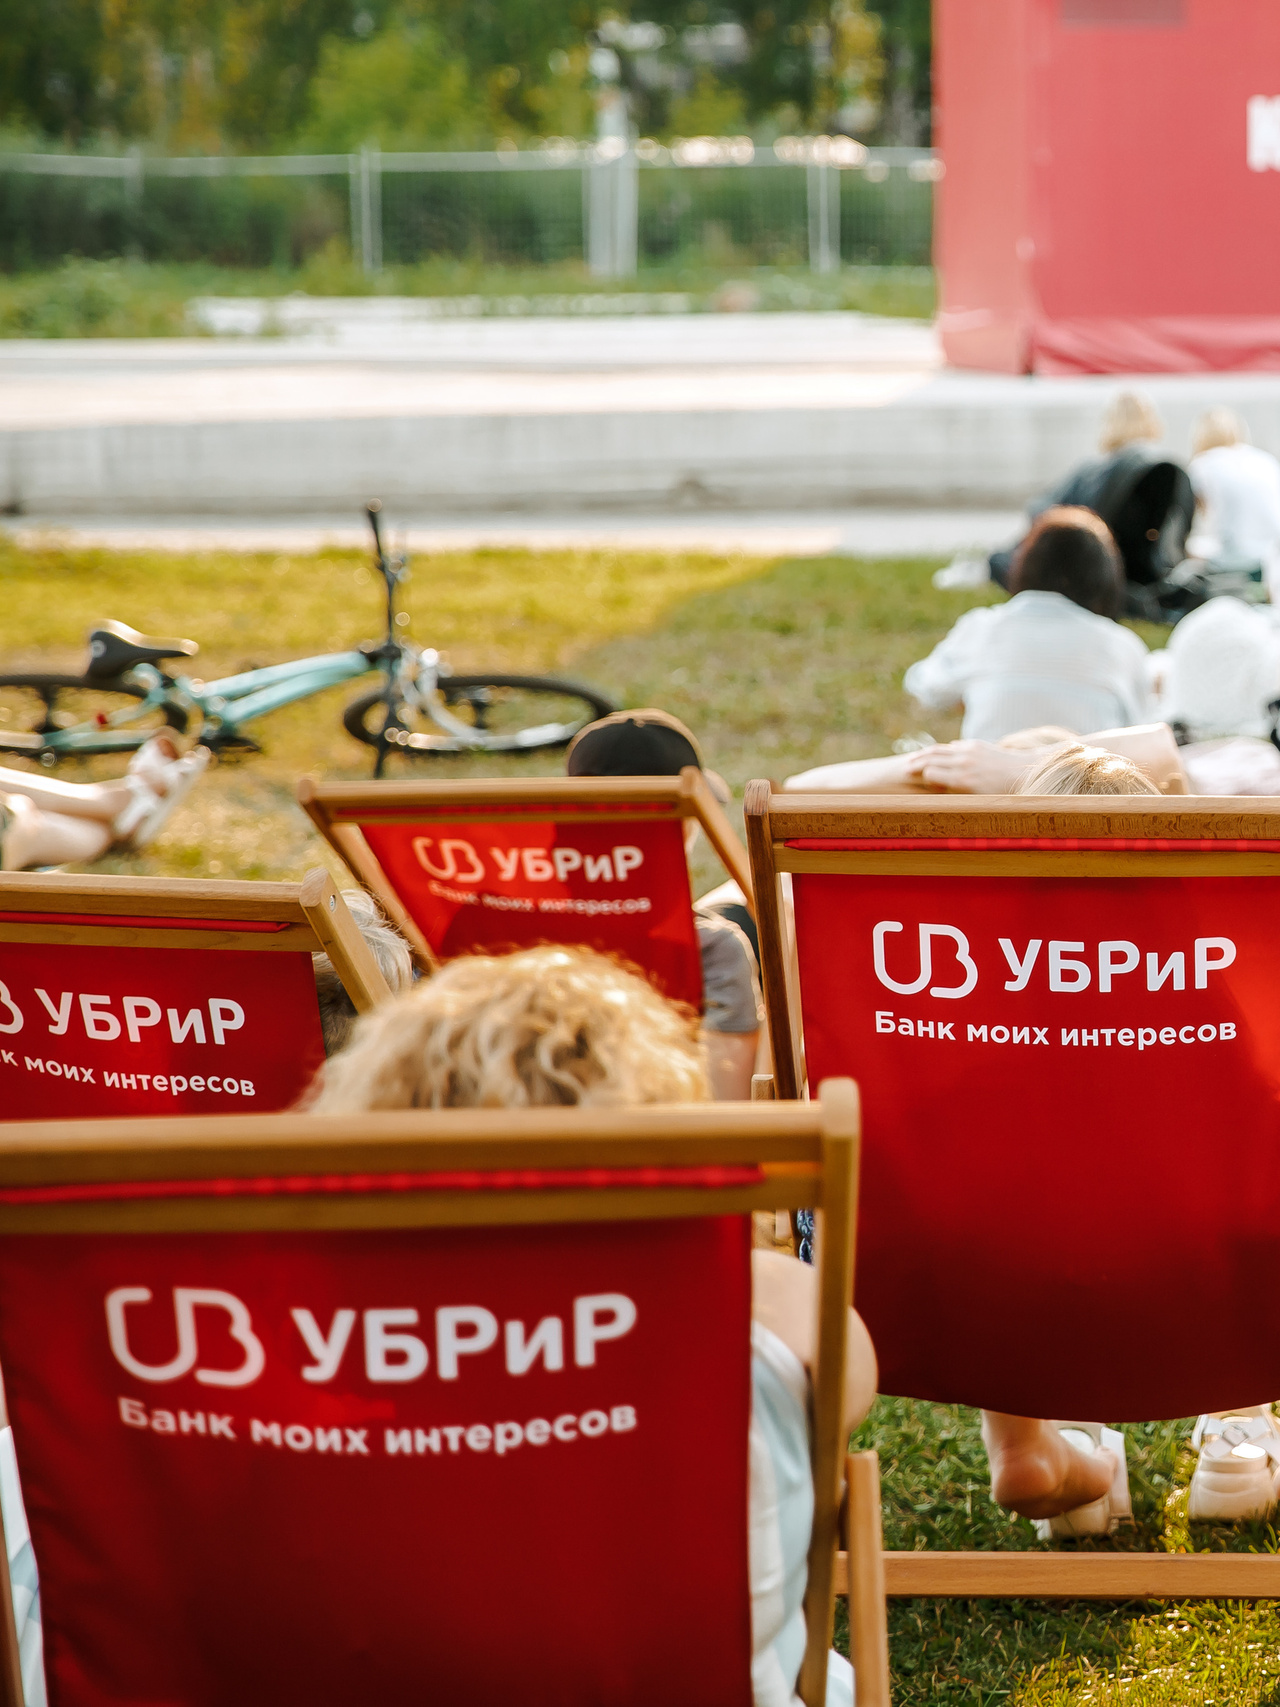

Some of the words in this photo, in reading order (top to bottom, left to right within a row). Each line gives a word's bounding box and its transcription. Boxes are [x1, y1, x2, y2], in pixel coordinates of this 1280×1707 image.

[491, 846, 643, 881] УБРиР
[998, 937, 1236, 992] УБРиР
[34, 988, 244, 1045] УБРиР
[876, 1011, 956, 1040] Банк
[967, 1024, 1049, 1045] моих
[1062, 1023, 1236, 1050] интересов
[24, 1057, 96, 1083] моих
[104, 1071, 255, 1096] интересов
[292, 1294, 636, 1382] УБРиР
[119, 1398, 235, 1439] Банк
[251, 1420, 368, 1454] моих
[385, 1406, 636, 1454] интересов
